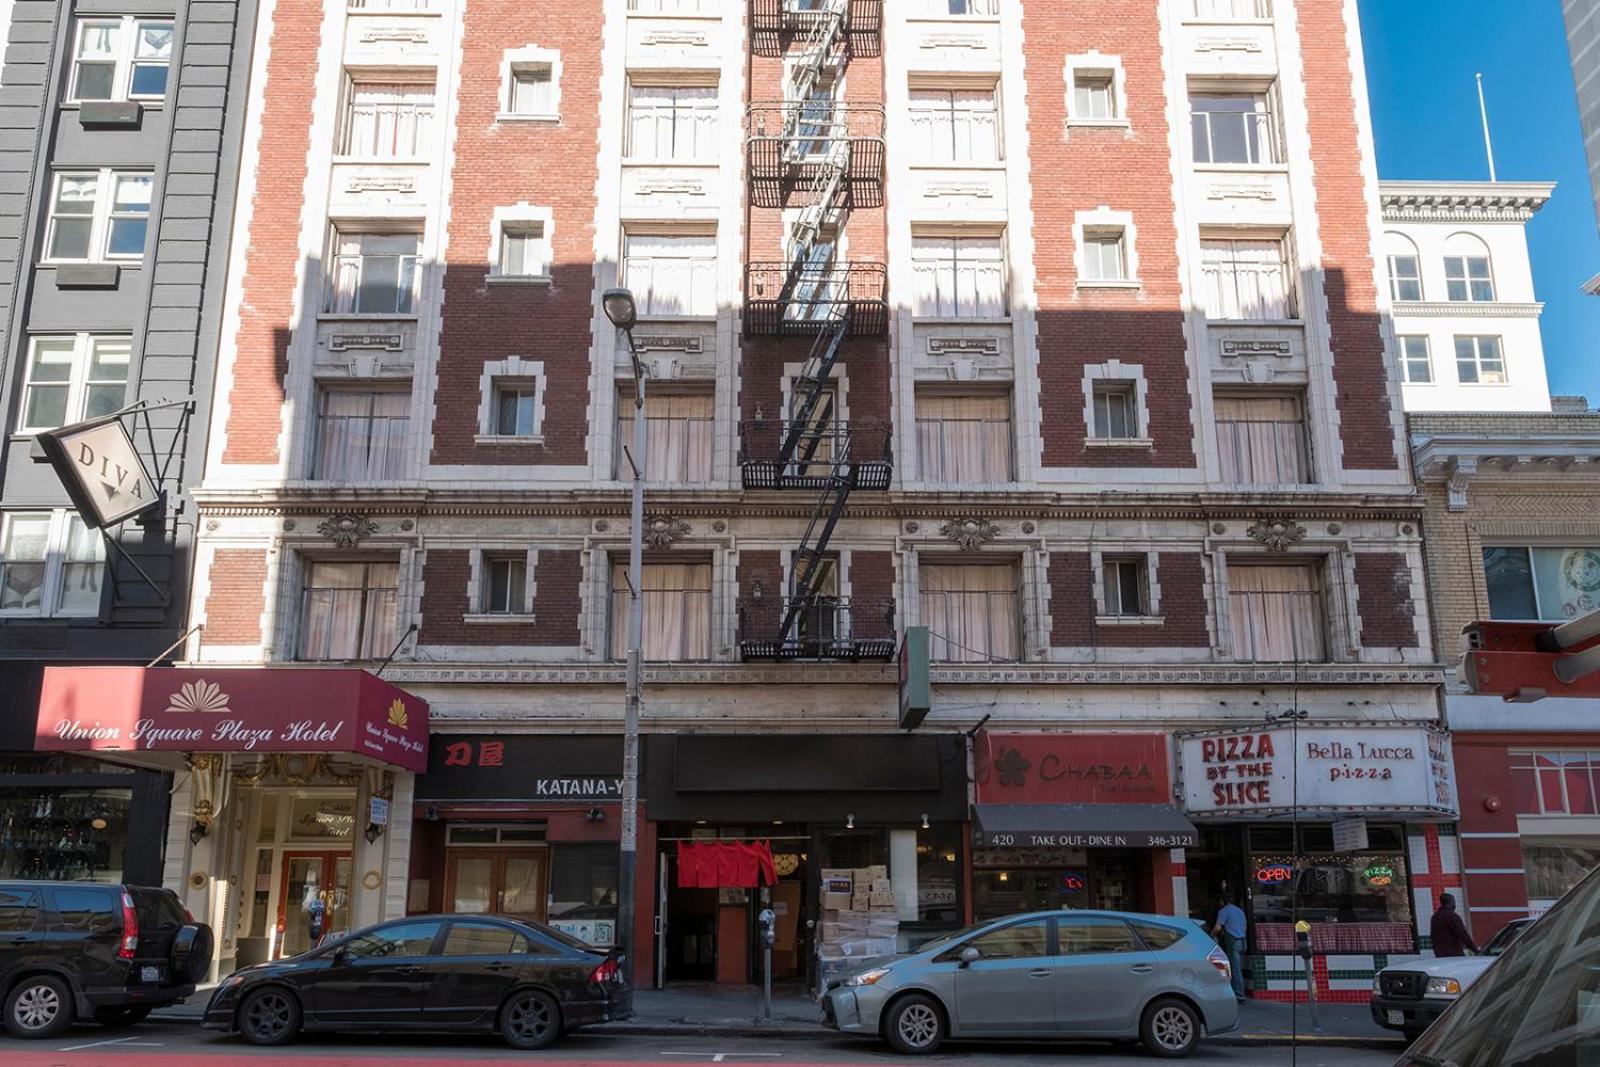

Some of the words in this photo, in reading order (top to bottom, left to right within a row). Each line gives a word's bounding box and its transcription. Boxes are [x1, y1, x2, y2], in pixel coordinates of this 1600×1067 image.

[78, 441, 143, 500] DIVA
[55, 718, 119, 740] Union
[128, 718, 203, 749] Square
[211, 718, 274, 750] Plaza
[280, 719, 344, 742] Hotel
[1202, 733, 1275, 763] PIZZA
[1306, 742, 1354, 760] Bella
[1357, 742, 1414, 760] Lucca
[1206, 765, 1229, 780] BY
[1235, 762, 1273, 778] THE
[1213, 780, 1271, 806] SLICE
[992, 834, 1014, 846] 420
[1031, 834, 1056, 846] TAKE
[1115, 834, 1127, 846] IN
[1147, 834, 1193, 846] 346-3121
[1257, 867, 1292, 881] OPEN
[1363, 866, 1393, 878] PIZZA
